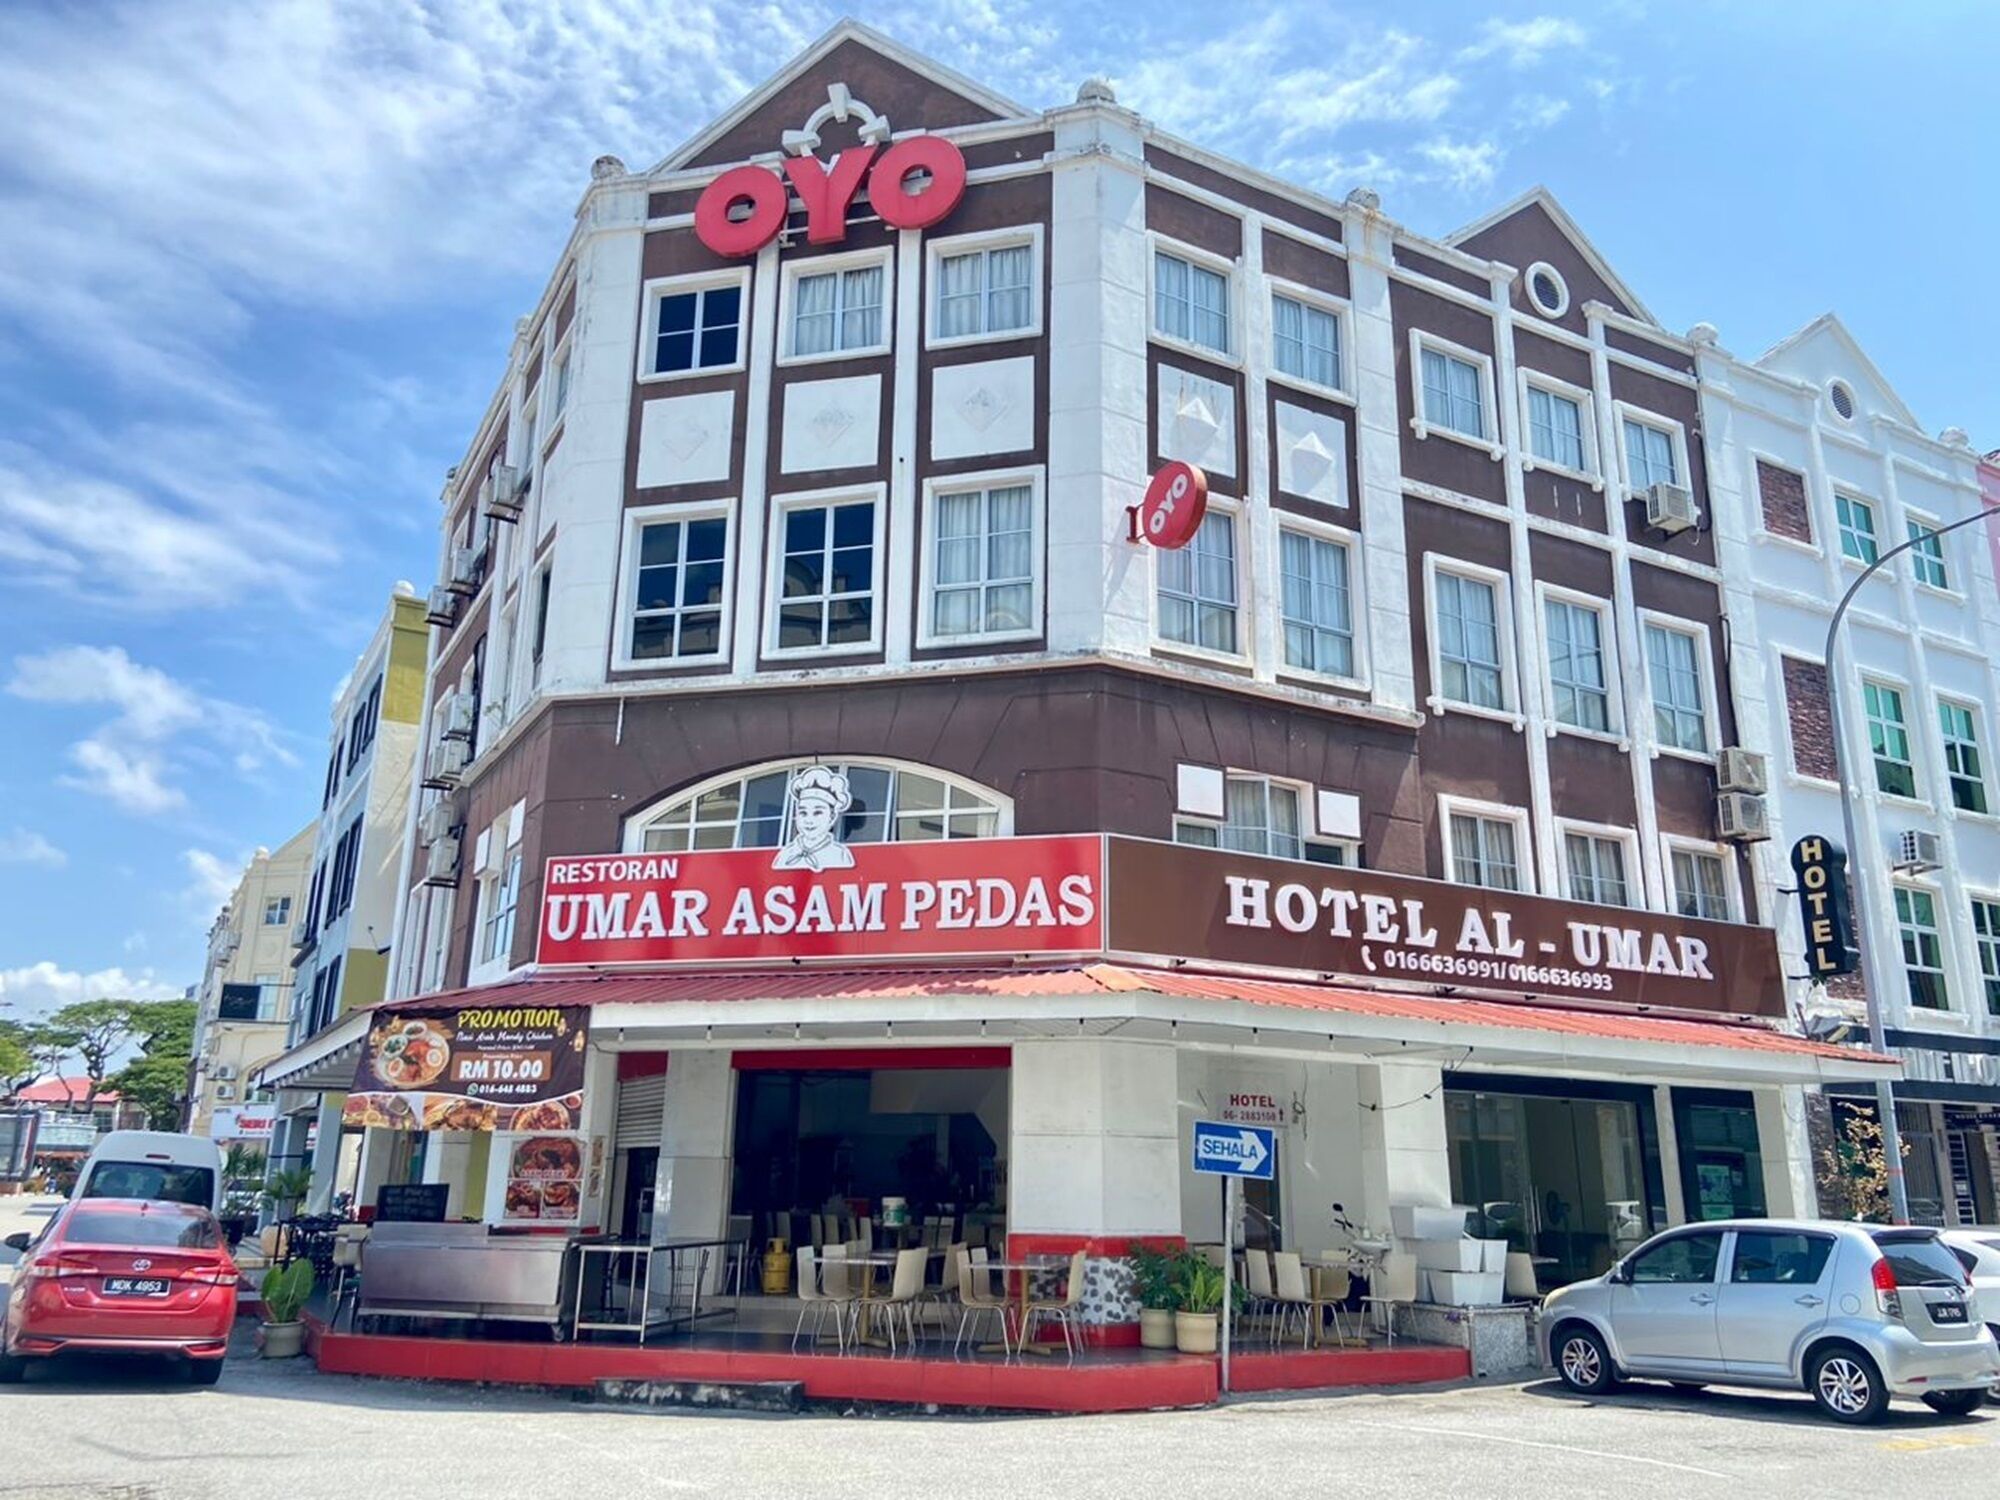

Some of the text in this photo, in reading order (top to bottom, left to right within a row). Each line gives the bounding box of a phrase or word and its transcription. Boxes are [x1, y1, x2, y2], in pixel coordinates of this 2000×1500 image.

[695, 135, 968, 258] OYO
[1149, 473, 1188, 535] OYO
[551, 859, 679, 885] RESTORAN
[547, 874, 1095, 942] UMAR ASAM PEDAS
[1225, 876, 1438, 948] HOTEL
[1456, 907, 1526, 959] AL
[1567, 921, 1714, 980] UMAR
[1800, 838, 1837, 971] HOTEL
[459, 1059, 544, 1079] RM 10.00
[1230, 1094, 1276, 1108] HOTEL
[1202, 1138, 1258, 1160] SEHALA
